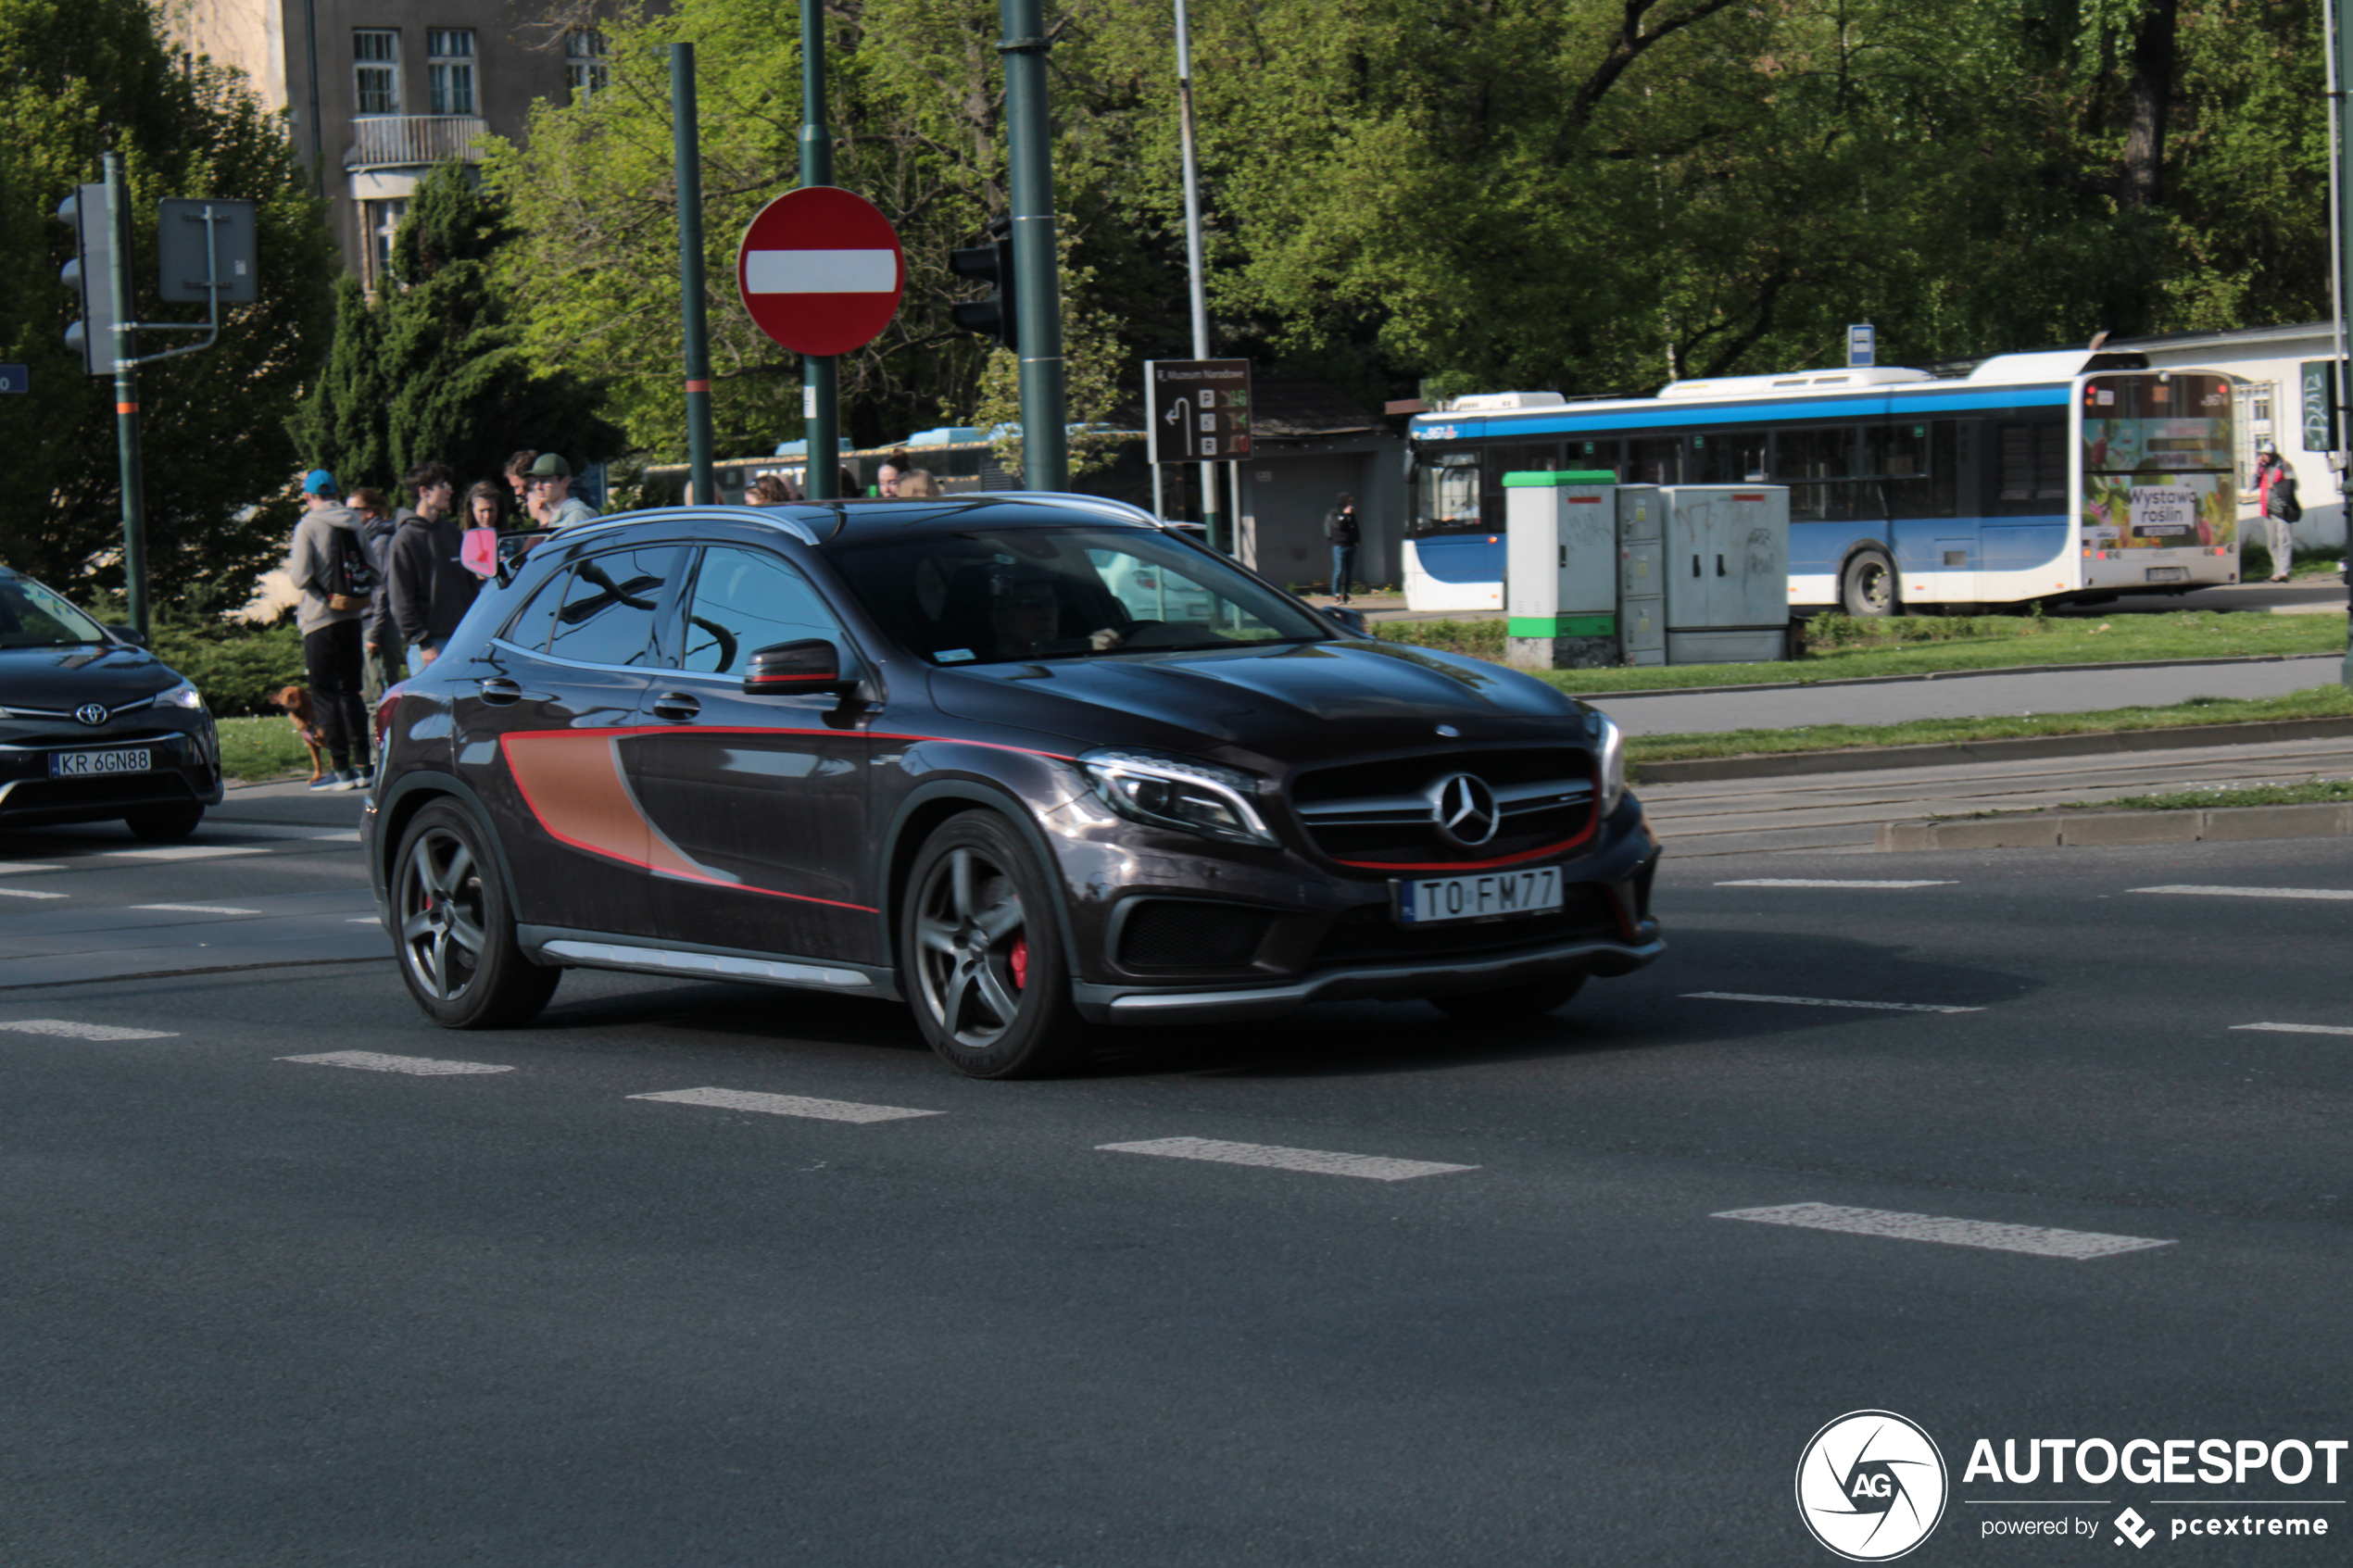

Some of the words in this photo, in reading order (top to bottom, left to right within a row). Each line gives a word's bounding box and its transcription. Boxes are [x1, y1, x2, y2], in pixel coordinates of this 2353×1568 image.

[2131, 488, 2196, 508] Wystawa
[2142, 506, 2183, 522] roślin
[62, 754, 88, 773] KR
[94, 750, 148, 771] 6GN88
[1478, 871, 1554, 912] FM77
